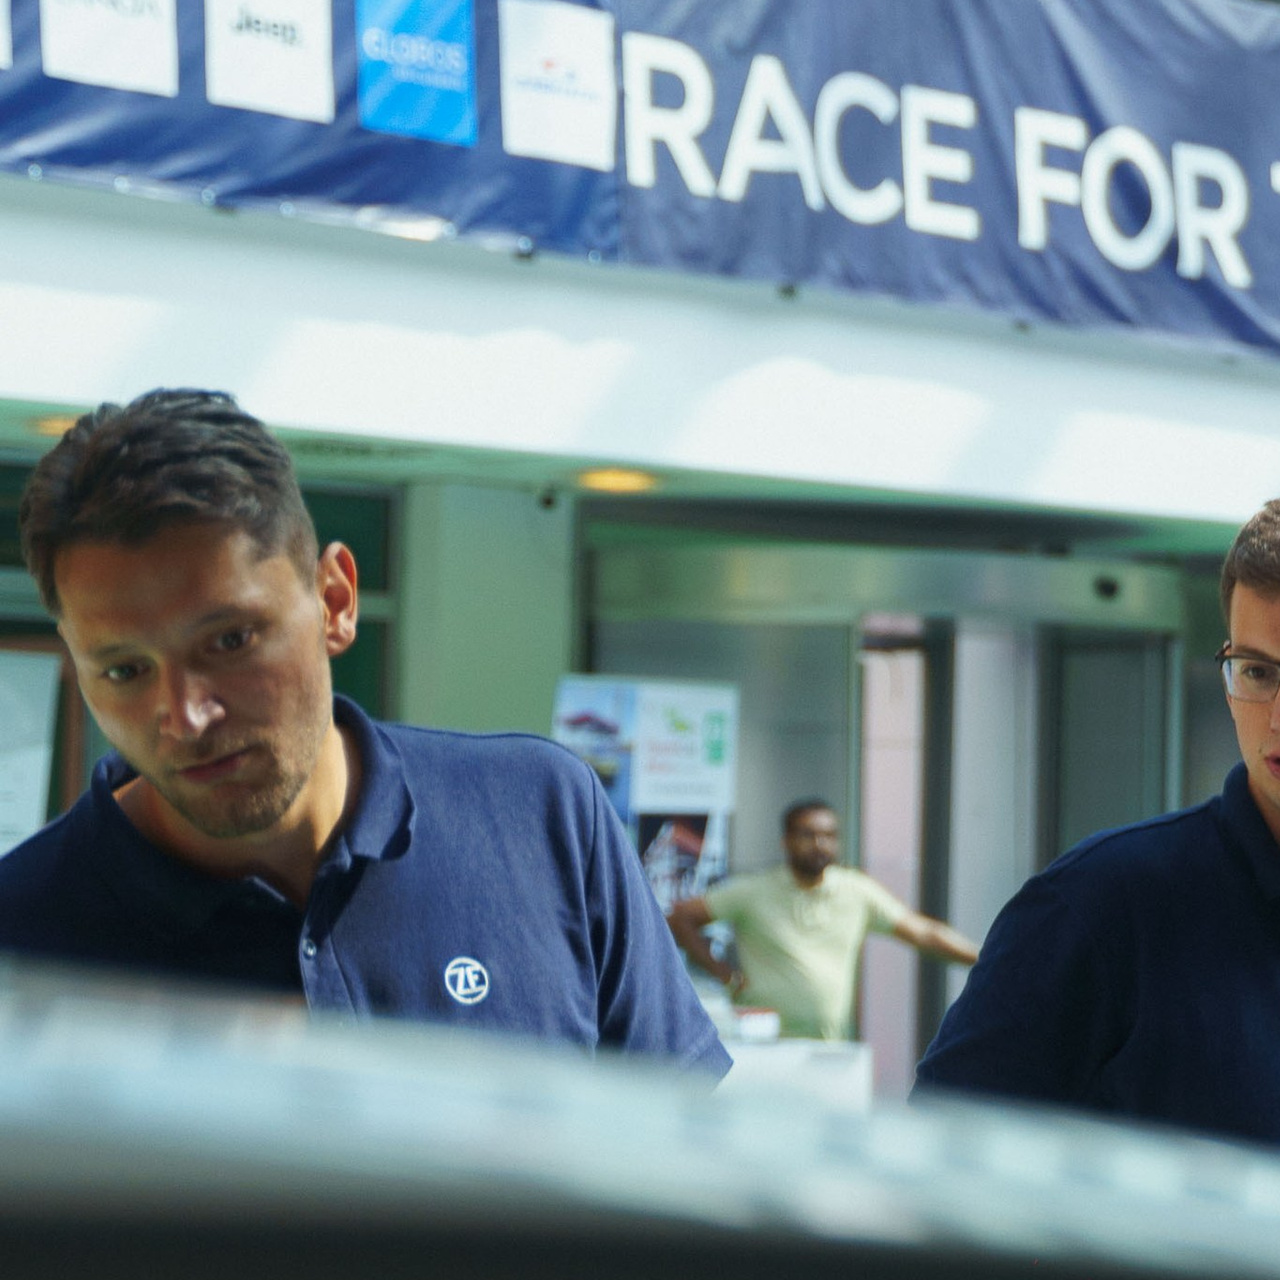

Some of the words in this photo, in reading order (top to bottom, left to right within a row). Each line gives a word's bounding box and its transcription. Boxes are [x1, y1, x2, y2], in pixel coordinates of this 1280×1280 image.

[622, 31, 980, 241] RACE
[1013, 106, 1252, 290] FOR
[446, 962, 488, 999] ZF
